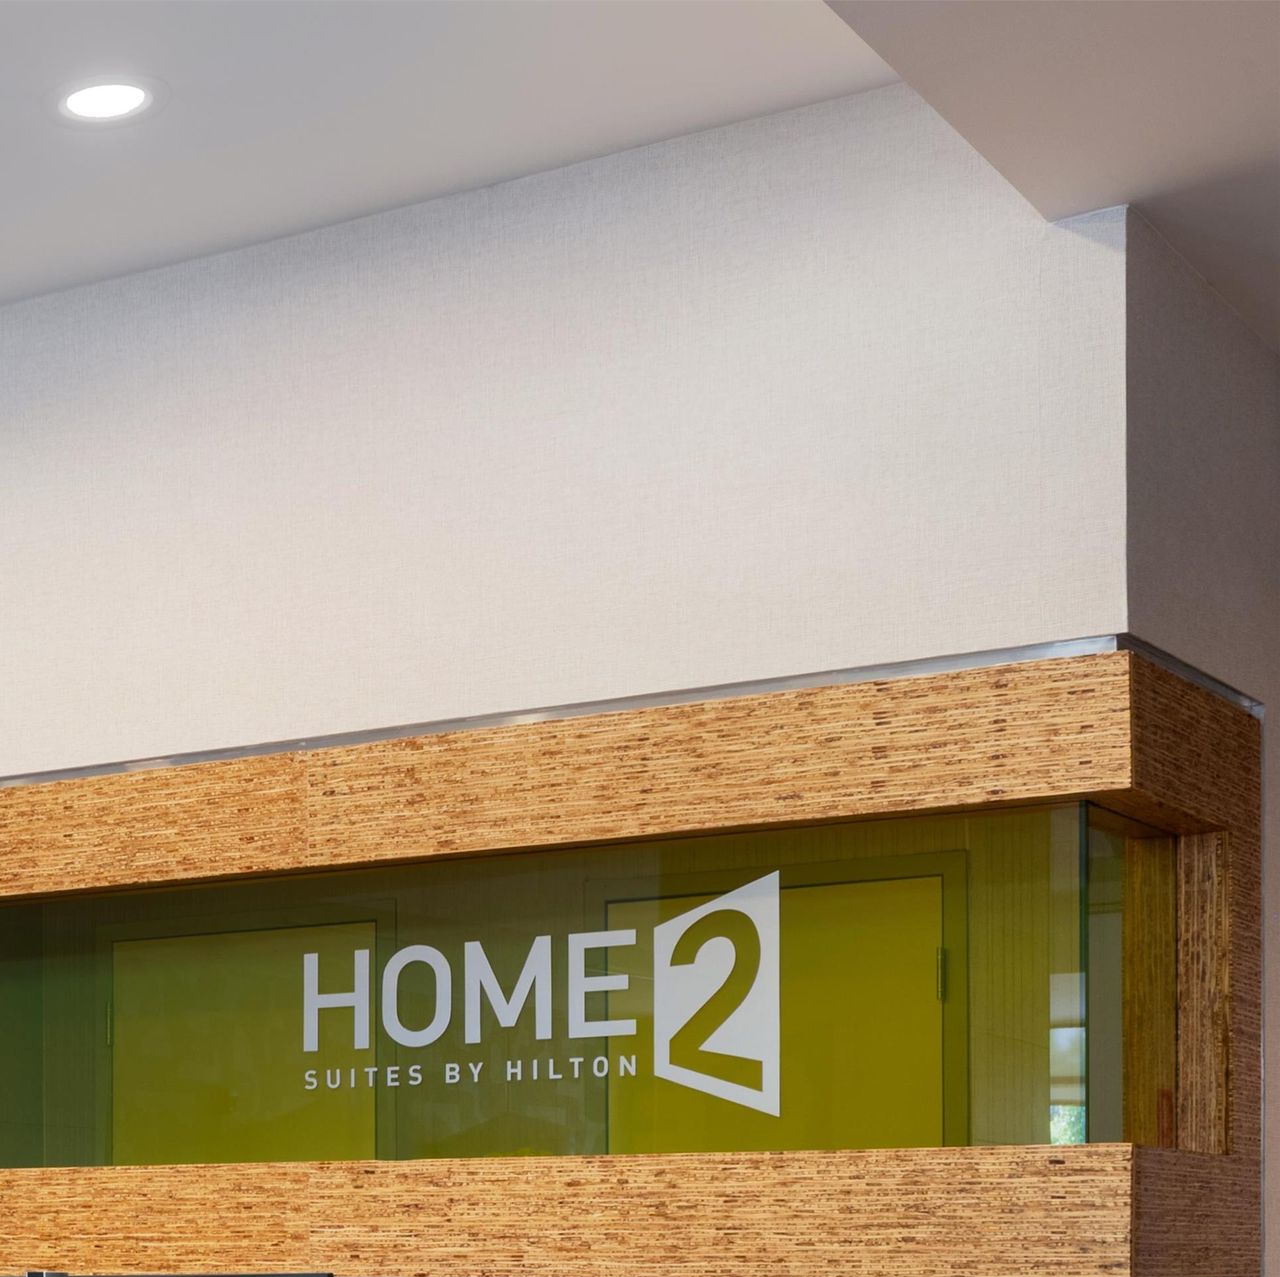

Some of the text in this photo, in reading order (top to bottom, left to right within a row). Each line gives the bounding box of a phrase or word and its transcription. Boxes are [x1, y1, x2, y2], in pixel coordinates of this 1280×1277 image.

[304, 1054, 638, 1090] SUITES BY HILTON
